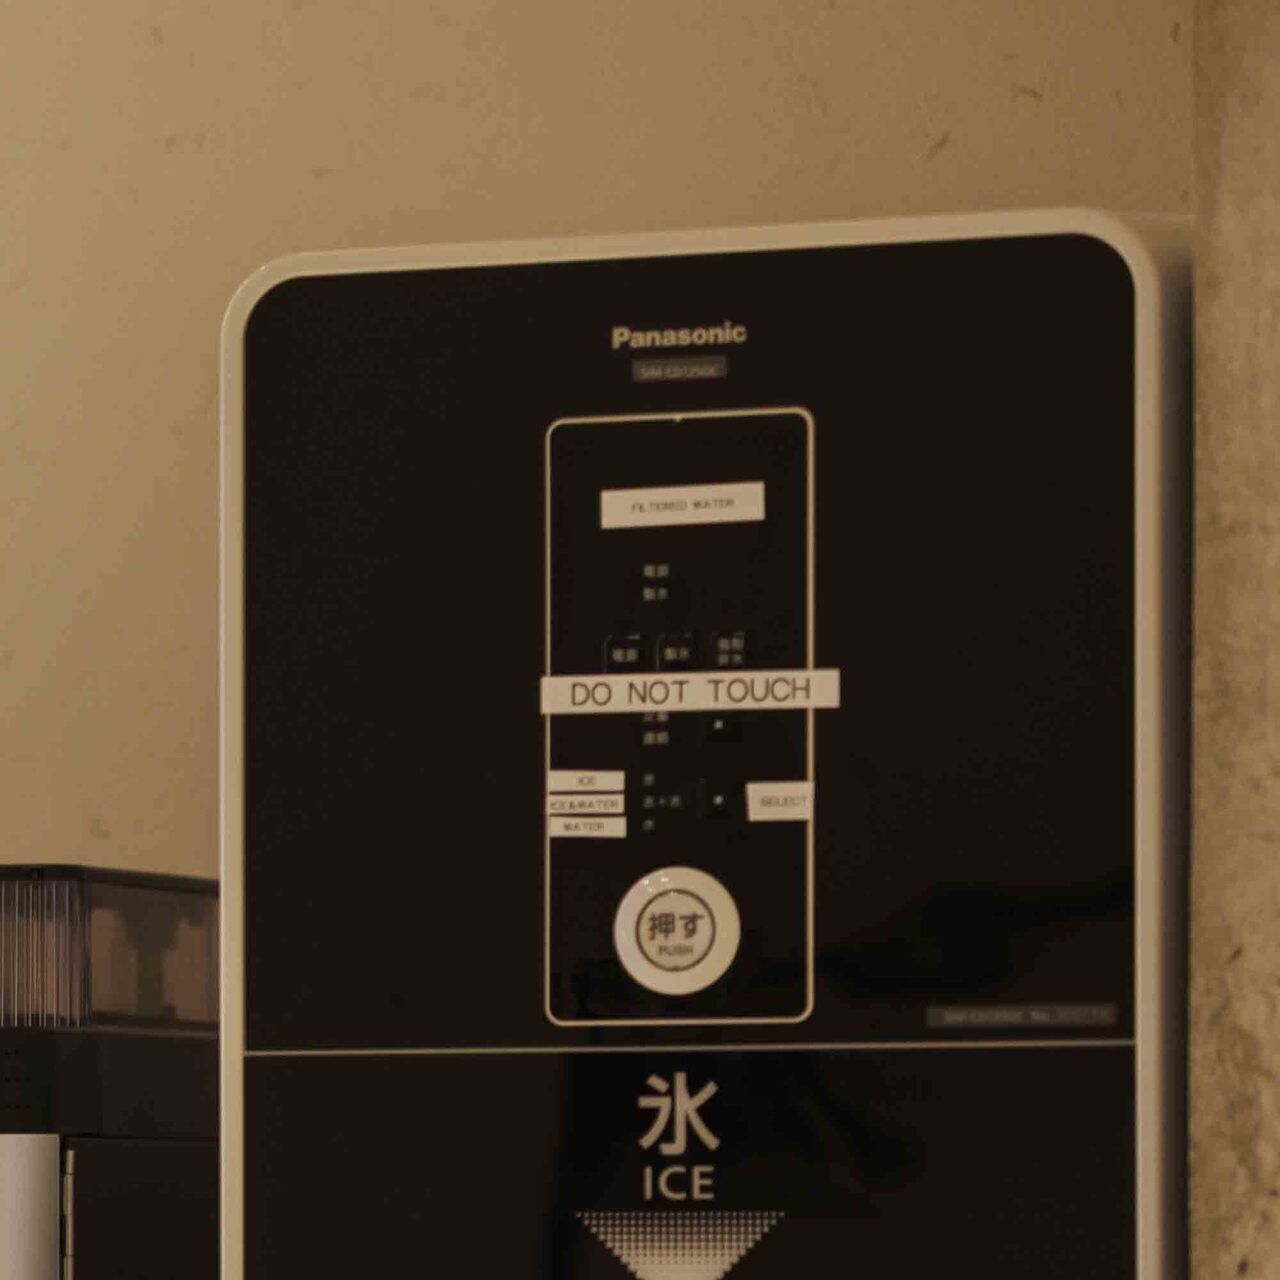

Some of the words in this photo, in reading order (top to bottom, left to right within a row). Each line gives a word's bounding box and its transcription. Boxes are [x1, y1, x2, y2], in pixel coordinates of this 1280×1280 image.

[611, 320, 747, 350] Panasonic
[571, 681, 612, 706] DO
[628, 680, 689, 704] NOT
[708, 677, 811, 702] TOUCH
[649, 912, 704, 941] 押す
[637, 1071, 721, 1156] 氷
[643, 1166, 715, 1200] ICE
